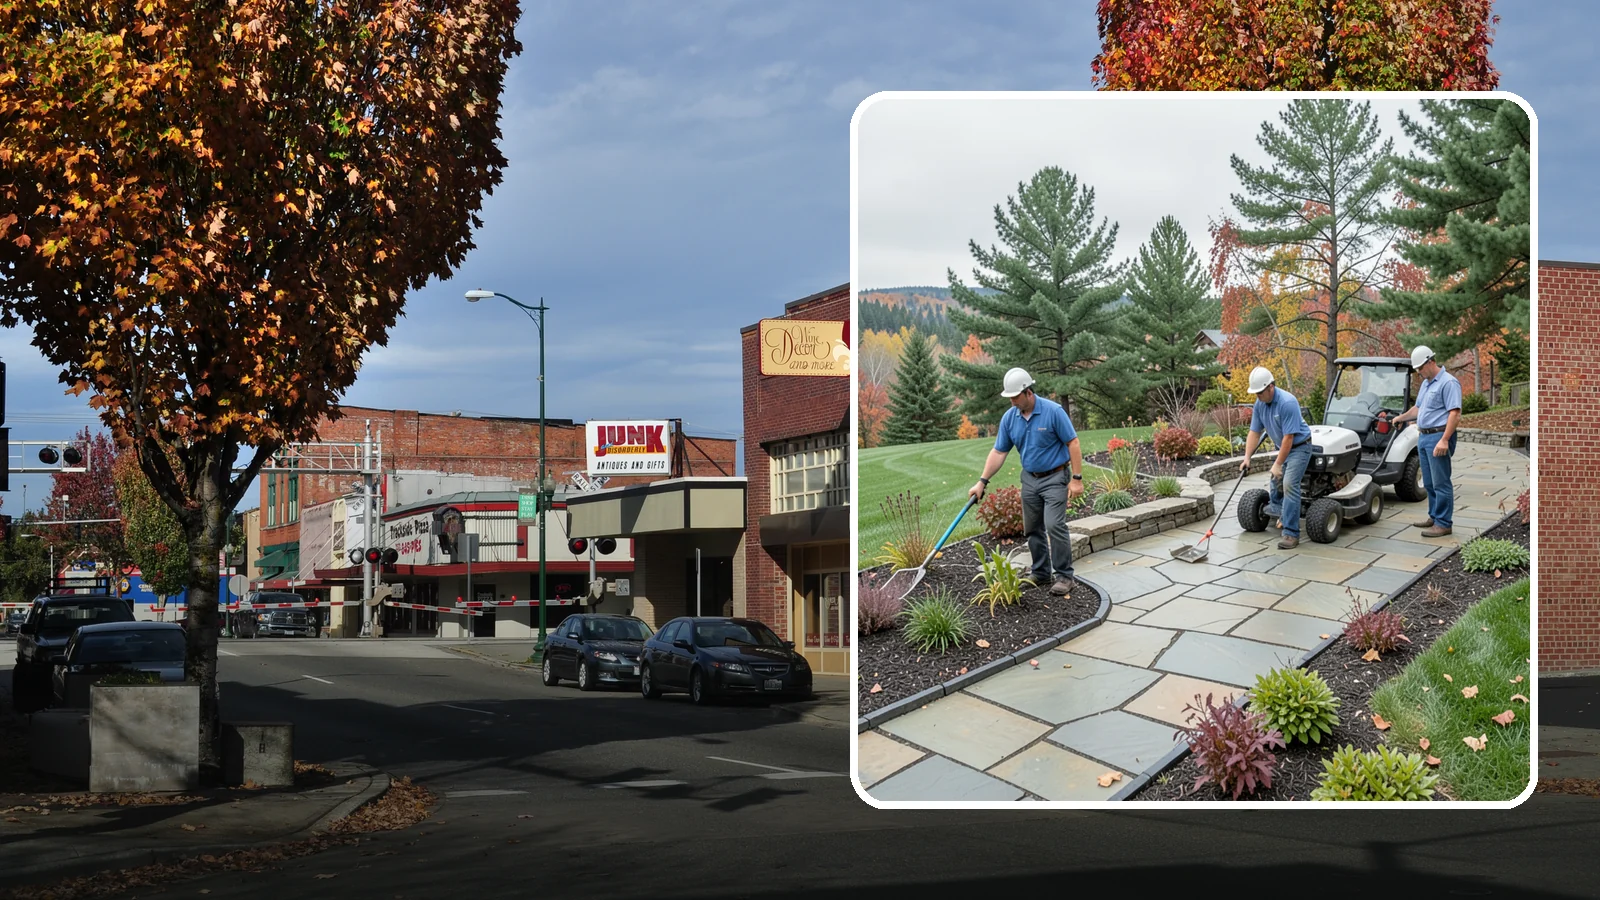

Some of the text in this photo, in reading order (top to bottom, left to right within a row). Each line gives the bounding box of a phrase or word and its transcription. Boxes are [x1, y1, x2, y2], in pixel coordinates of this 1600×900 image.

[595, 425, 665, 457] JUNK
[607, 446, 646, 454] DISORDERLY
[597, 460, 665, 470] ANTIQUES AND GIFTS
[390, 519, 429, 539] Trackside Pizza
